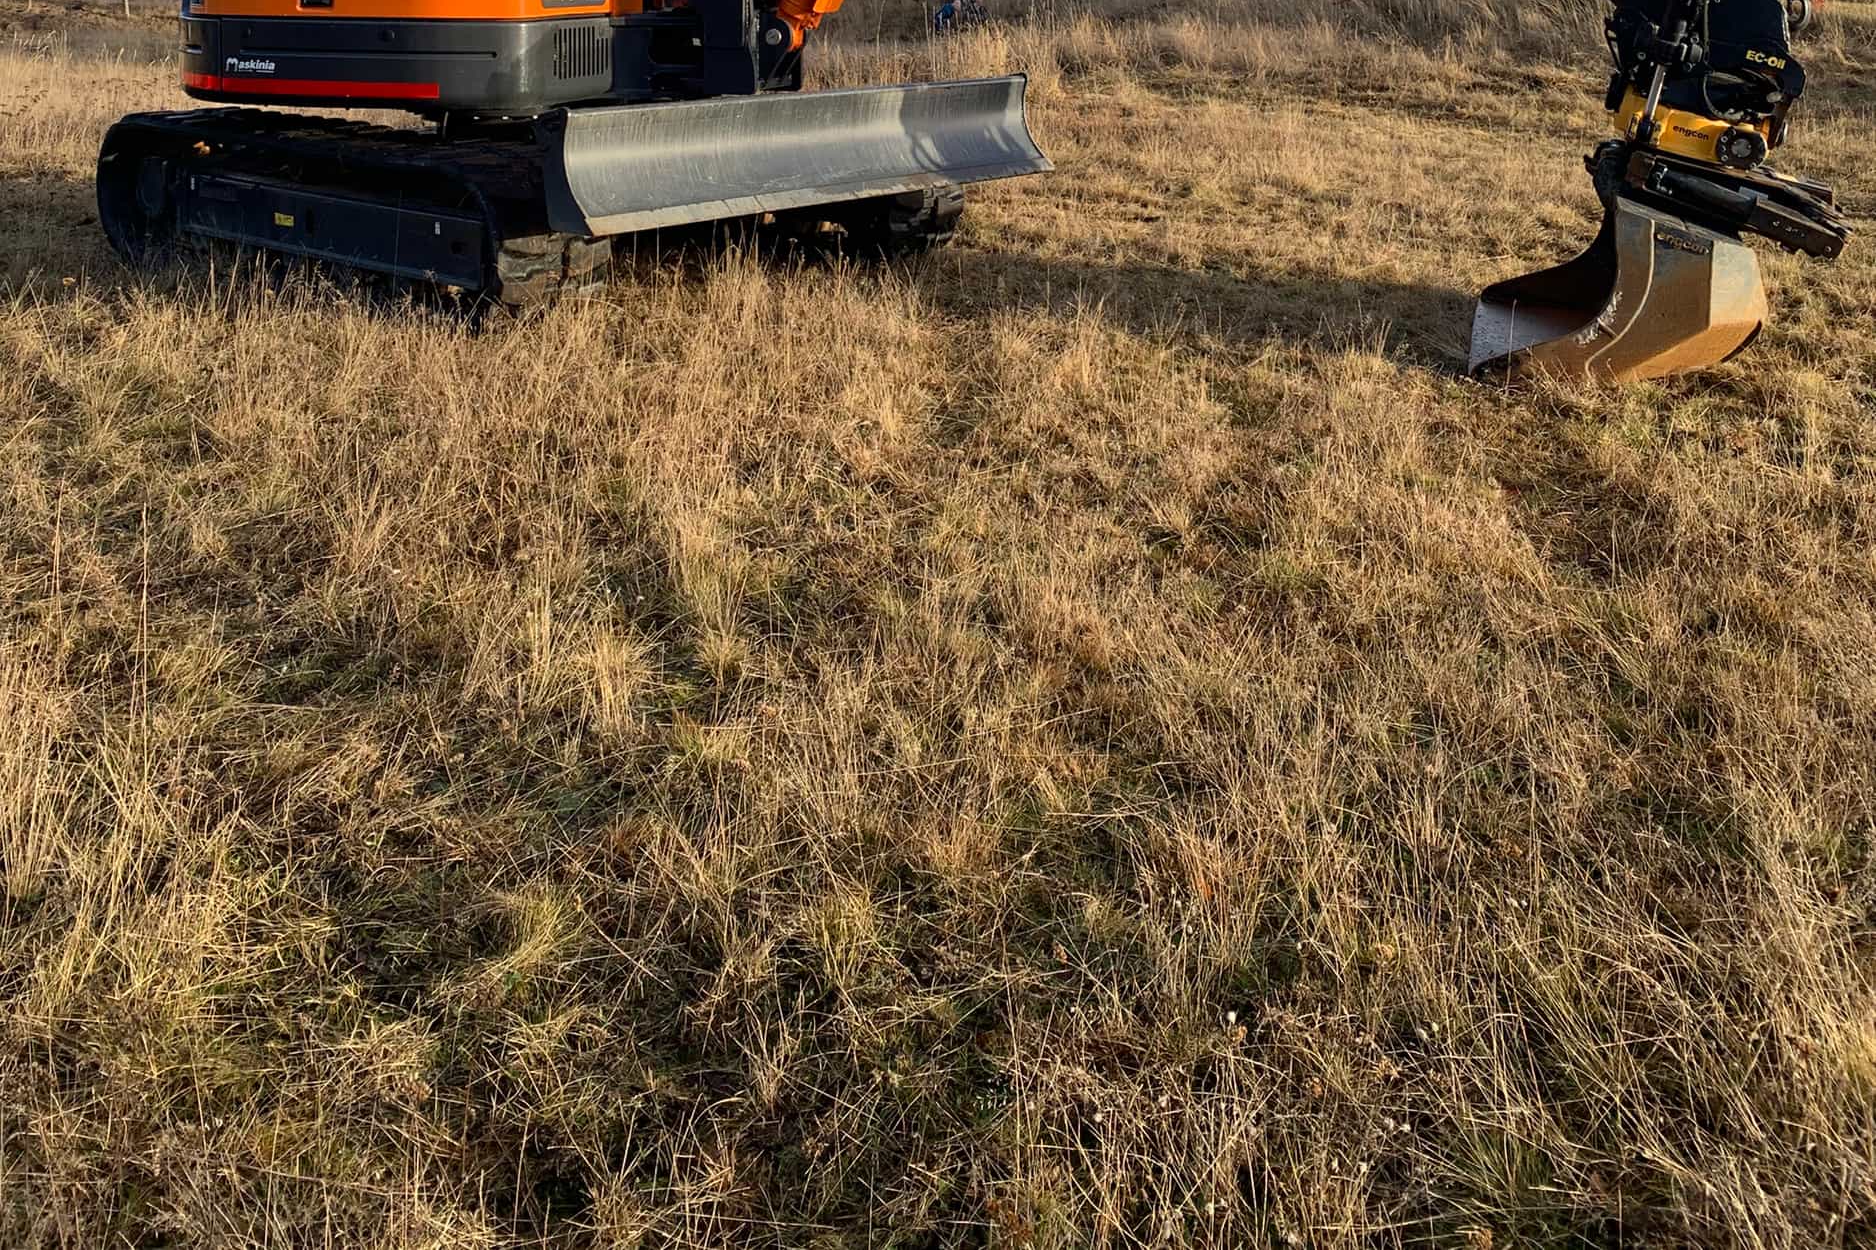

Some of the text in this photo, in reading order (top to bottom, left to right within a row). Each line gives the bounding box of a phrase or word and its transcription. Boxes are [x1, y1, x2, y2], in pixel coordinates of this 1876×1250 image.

[225, 57, 276, 72] Maskinia
[1746, 49, 1786, 69] EC-Oil
[1672, 125, 1709, 141] engcon
